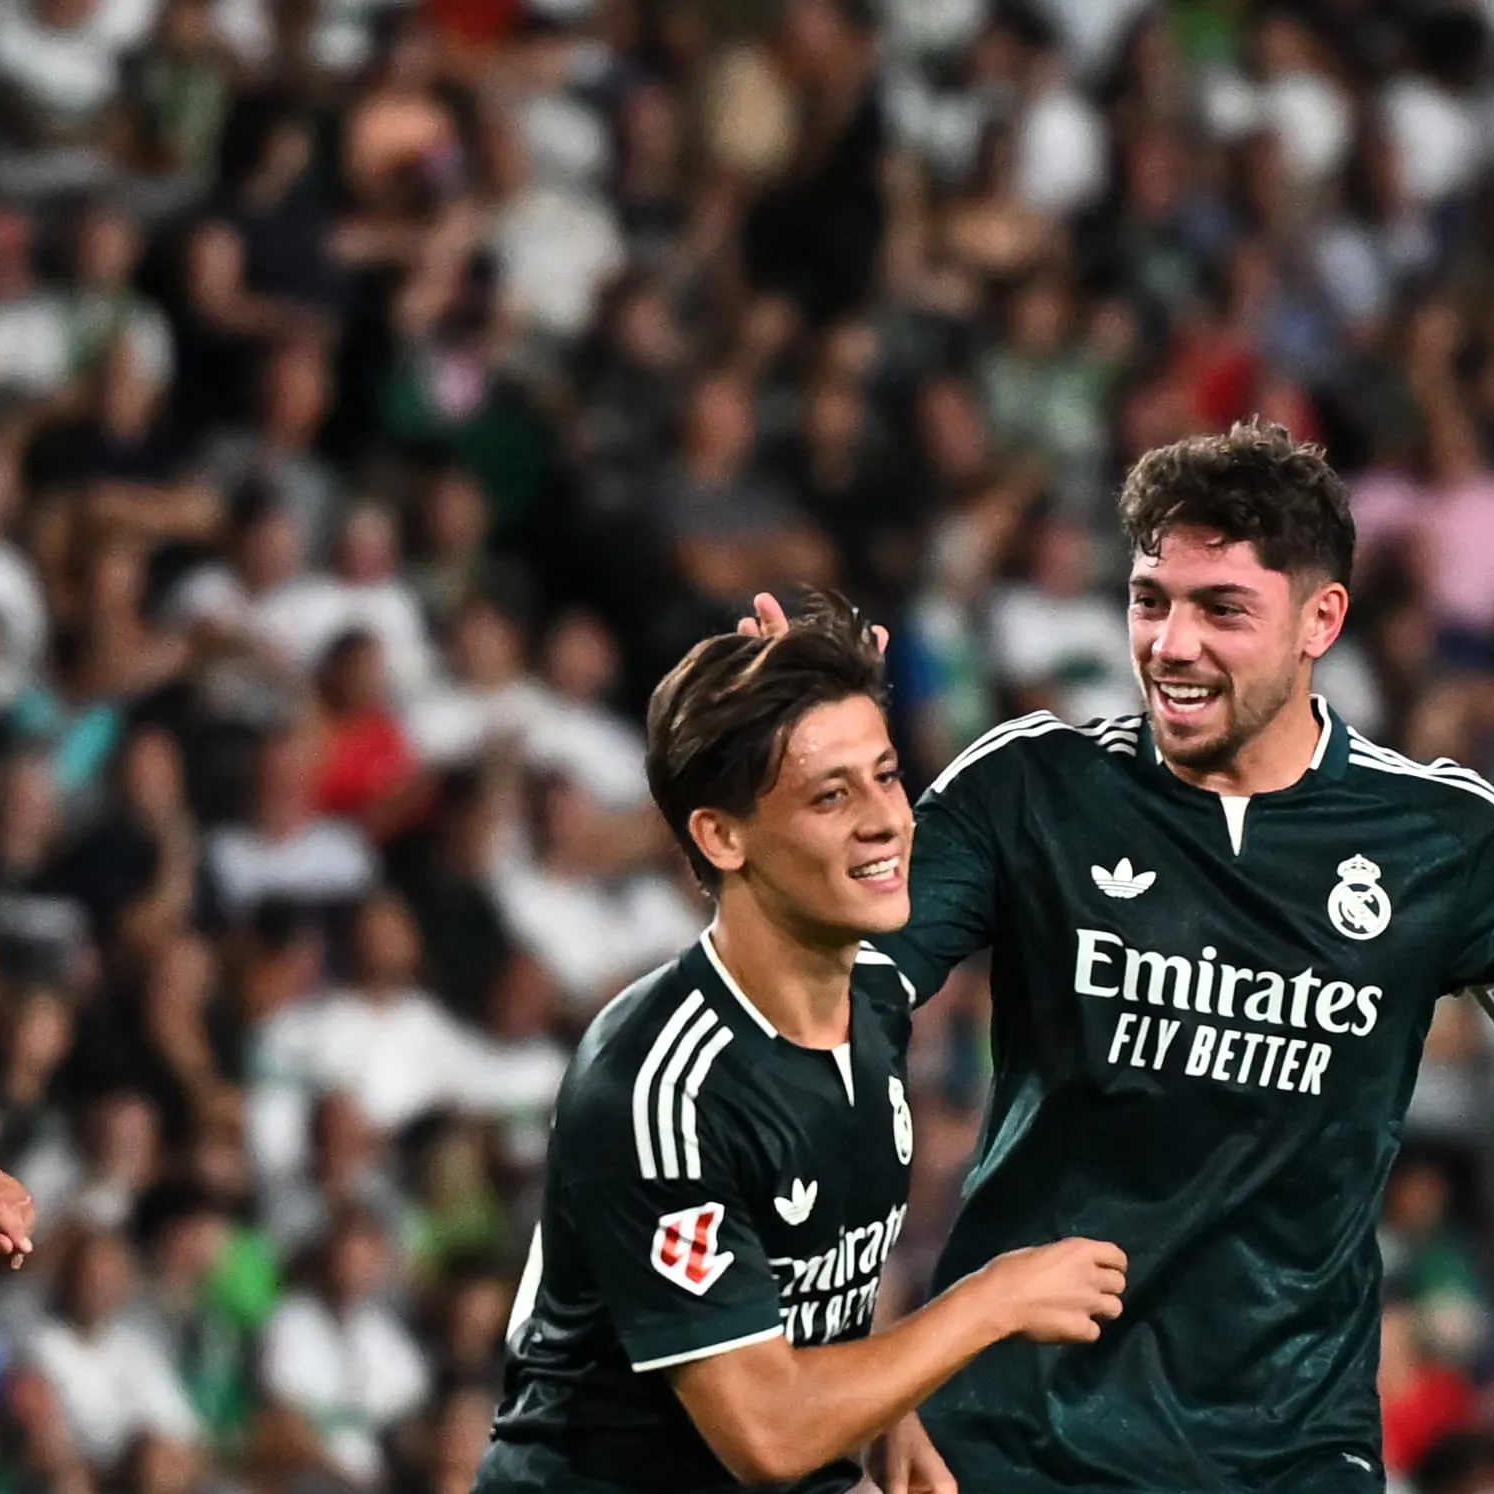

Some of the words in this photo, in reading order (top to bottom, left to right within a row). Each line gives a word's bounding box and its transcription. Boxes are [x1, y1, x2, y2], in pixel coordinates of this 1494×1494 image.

[1074, 928, 1382, 1037] Emirates
[1107, 1012, 1182, 1071] FLY
[1185, 1027, 1332, 1095] BETTER
